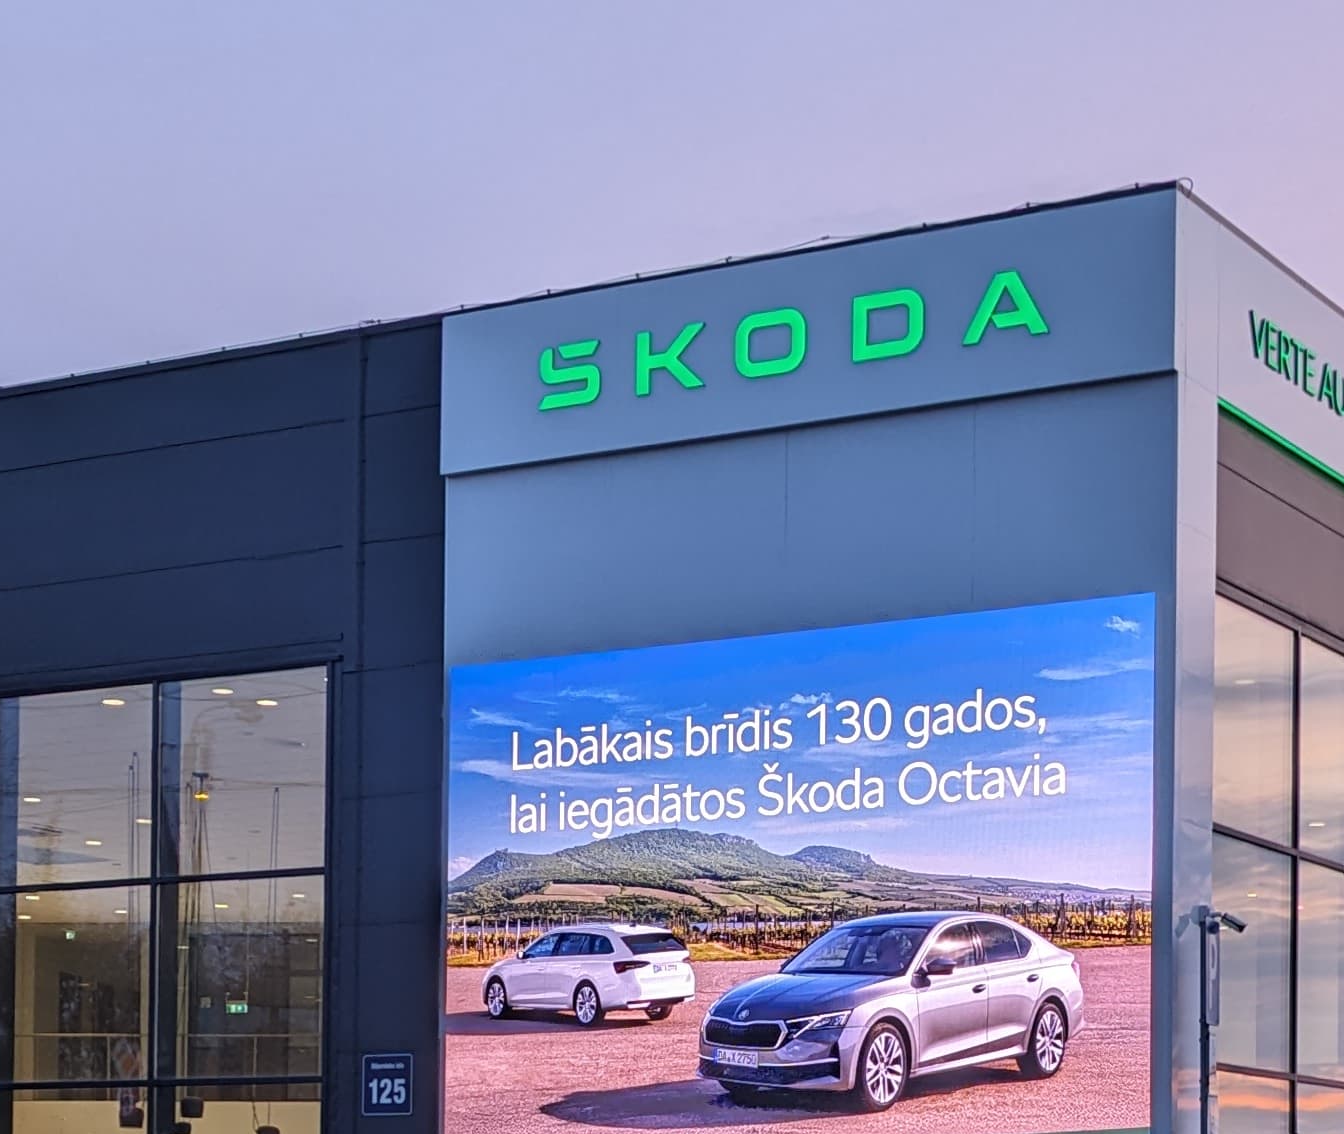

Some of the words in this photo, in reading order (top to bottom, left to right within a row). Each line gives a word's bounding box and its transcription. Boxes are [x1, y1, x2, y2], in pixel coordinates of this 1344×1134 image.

[1248, 309, 1316, 398] VERTE
[511, 718, 673, 772] Labākais
[684, 708, 793, 757] brīdis
[805, 696, 893, 746] 130
[903, 687, 1048, 750] gados,
[509, 793, 548, 834] lai
[557, 782, 746, 840] iegādātos
[756, 762, 885, 817] Škoda
[897, 752, 1068, 808] Octavia
[369, 1078, 406, 1105] 125
